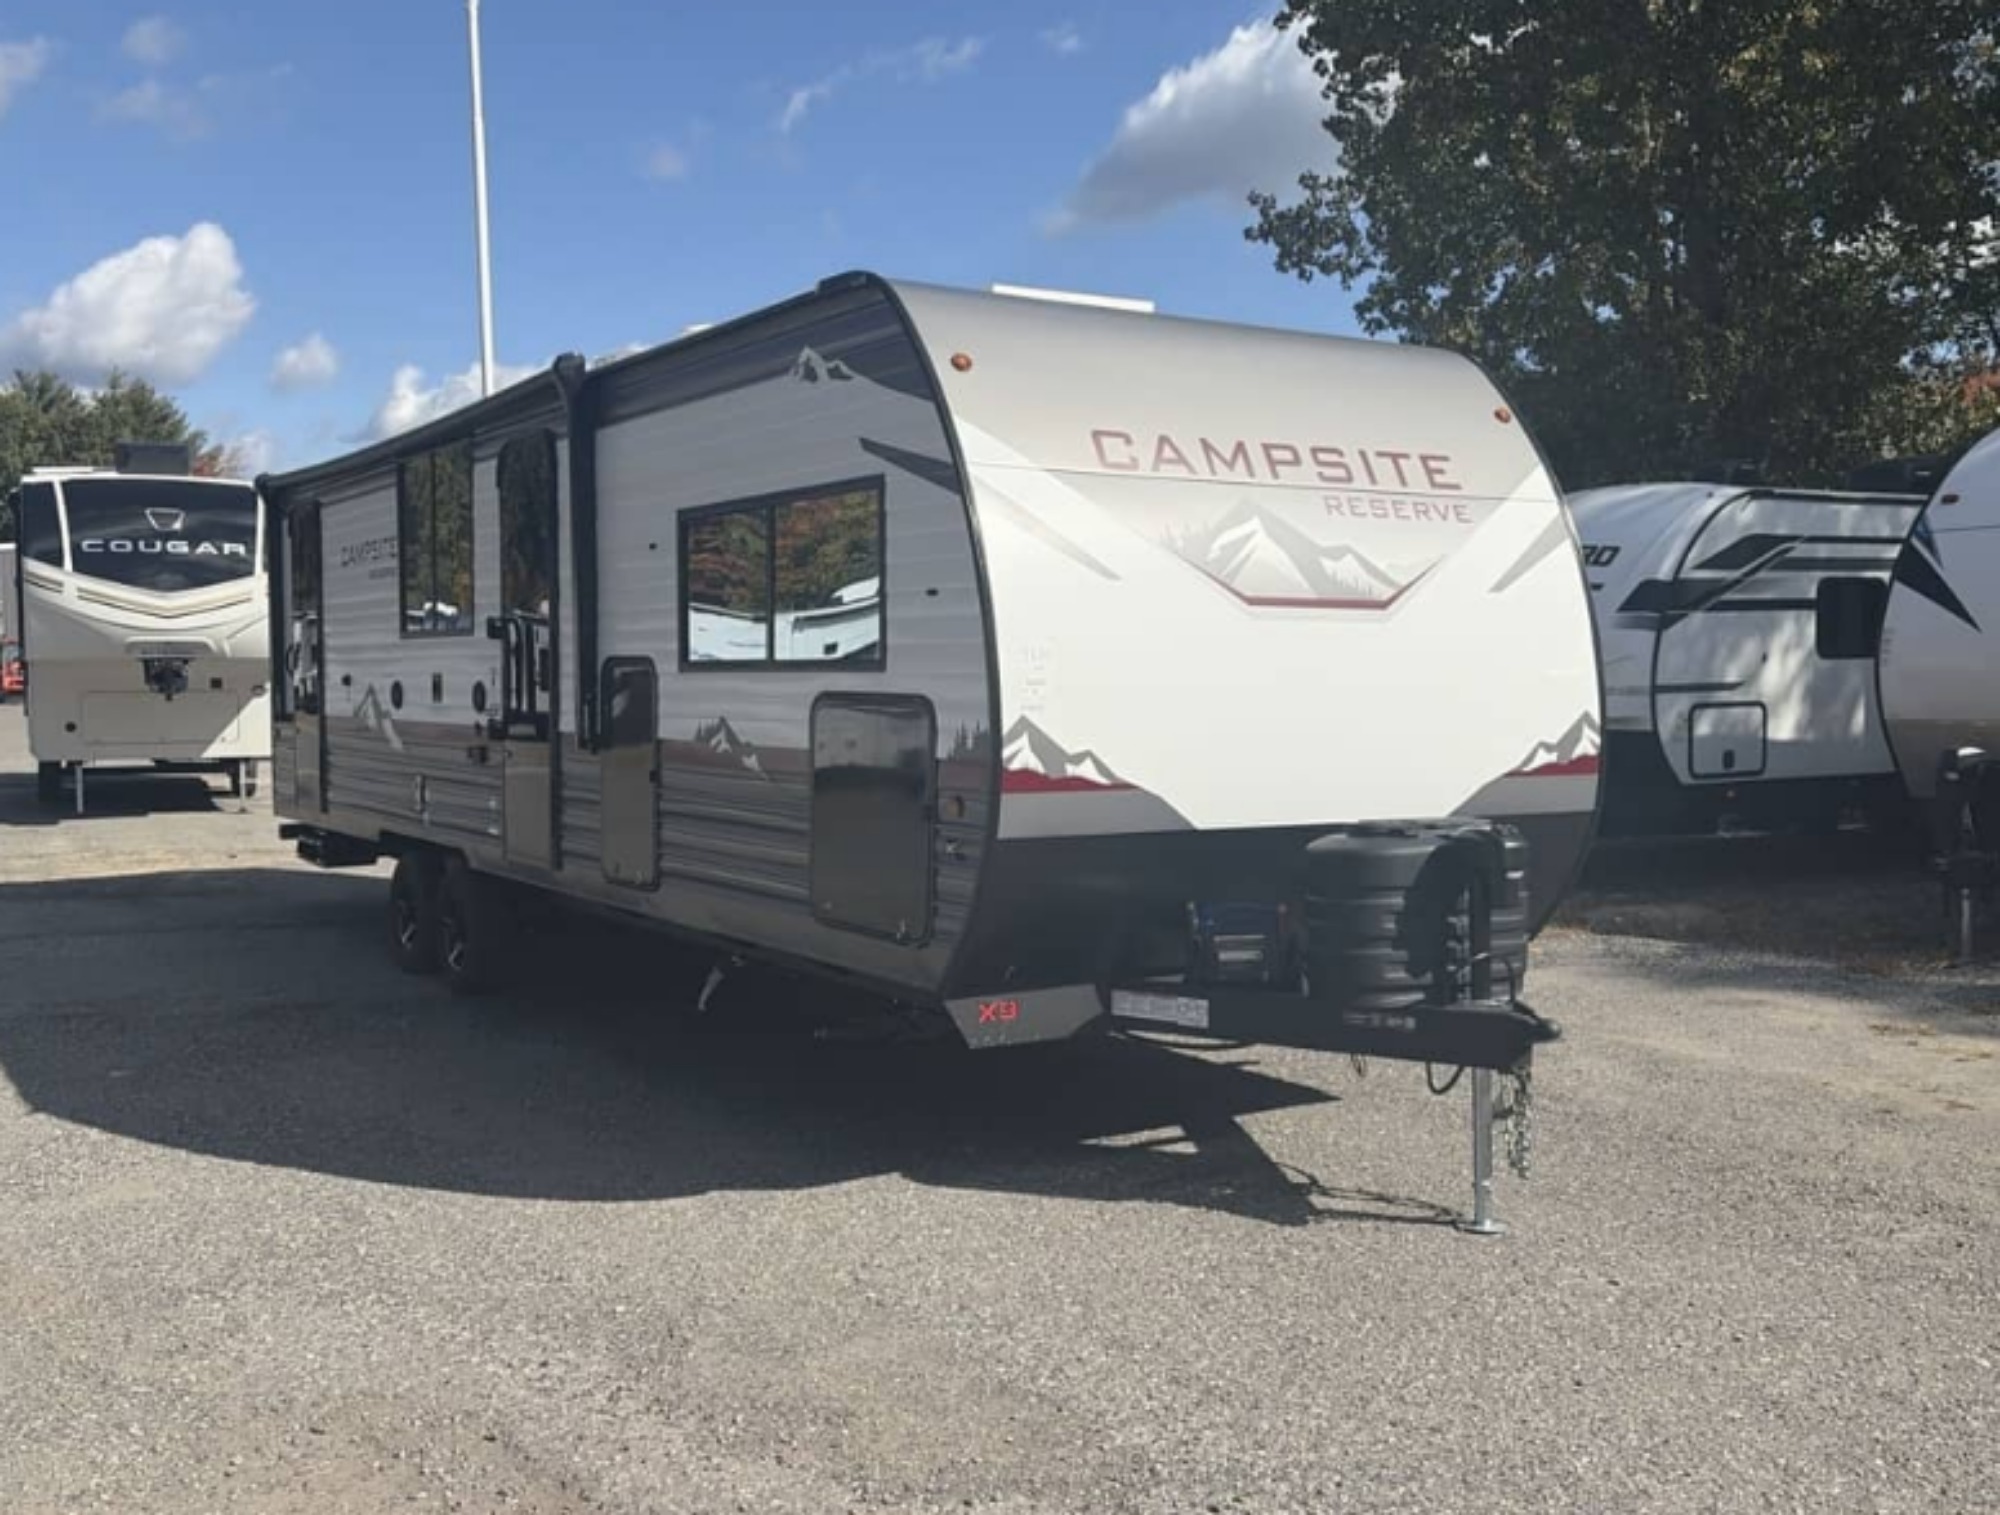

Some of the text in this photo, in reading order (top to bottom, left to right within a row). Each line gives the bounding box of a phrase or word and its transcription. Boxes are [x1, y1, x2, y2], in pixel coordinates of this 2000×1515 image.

[1091, 430, 1463, 491] CAMPSITE
[1324, 497, 1474, 524] RESERVE
[81, 538, 246, 556] COUGAR
